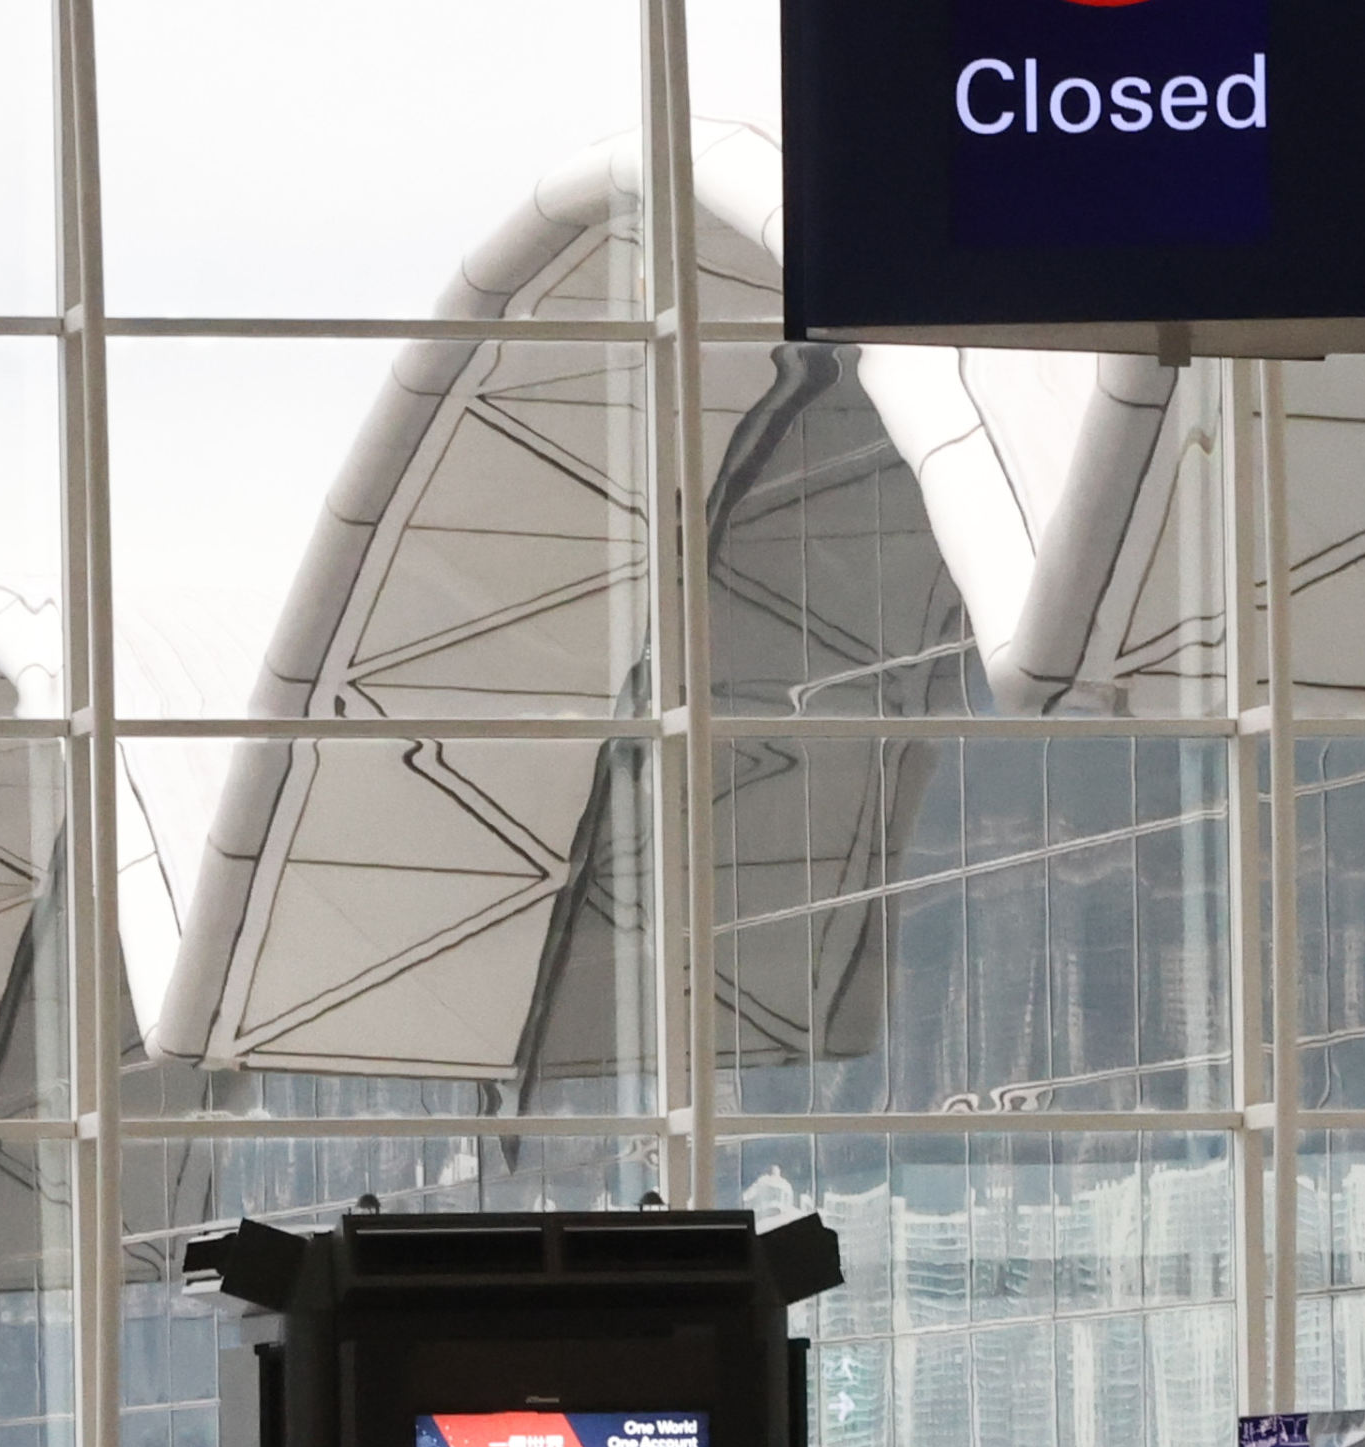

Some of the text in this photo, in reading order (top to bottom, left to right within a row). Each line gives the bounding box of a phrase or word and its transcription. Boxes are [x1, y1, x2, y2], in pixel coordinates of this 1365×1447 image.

[954, 53, 1268, 136] Closed
[623, 1418, 698, 1435] One World
